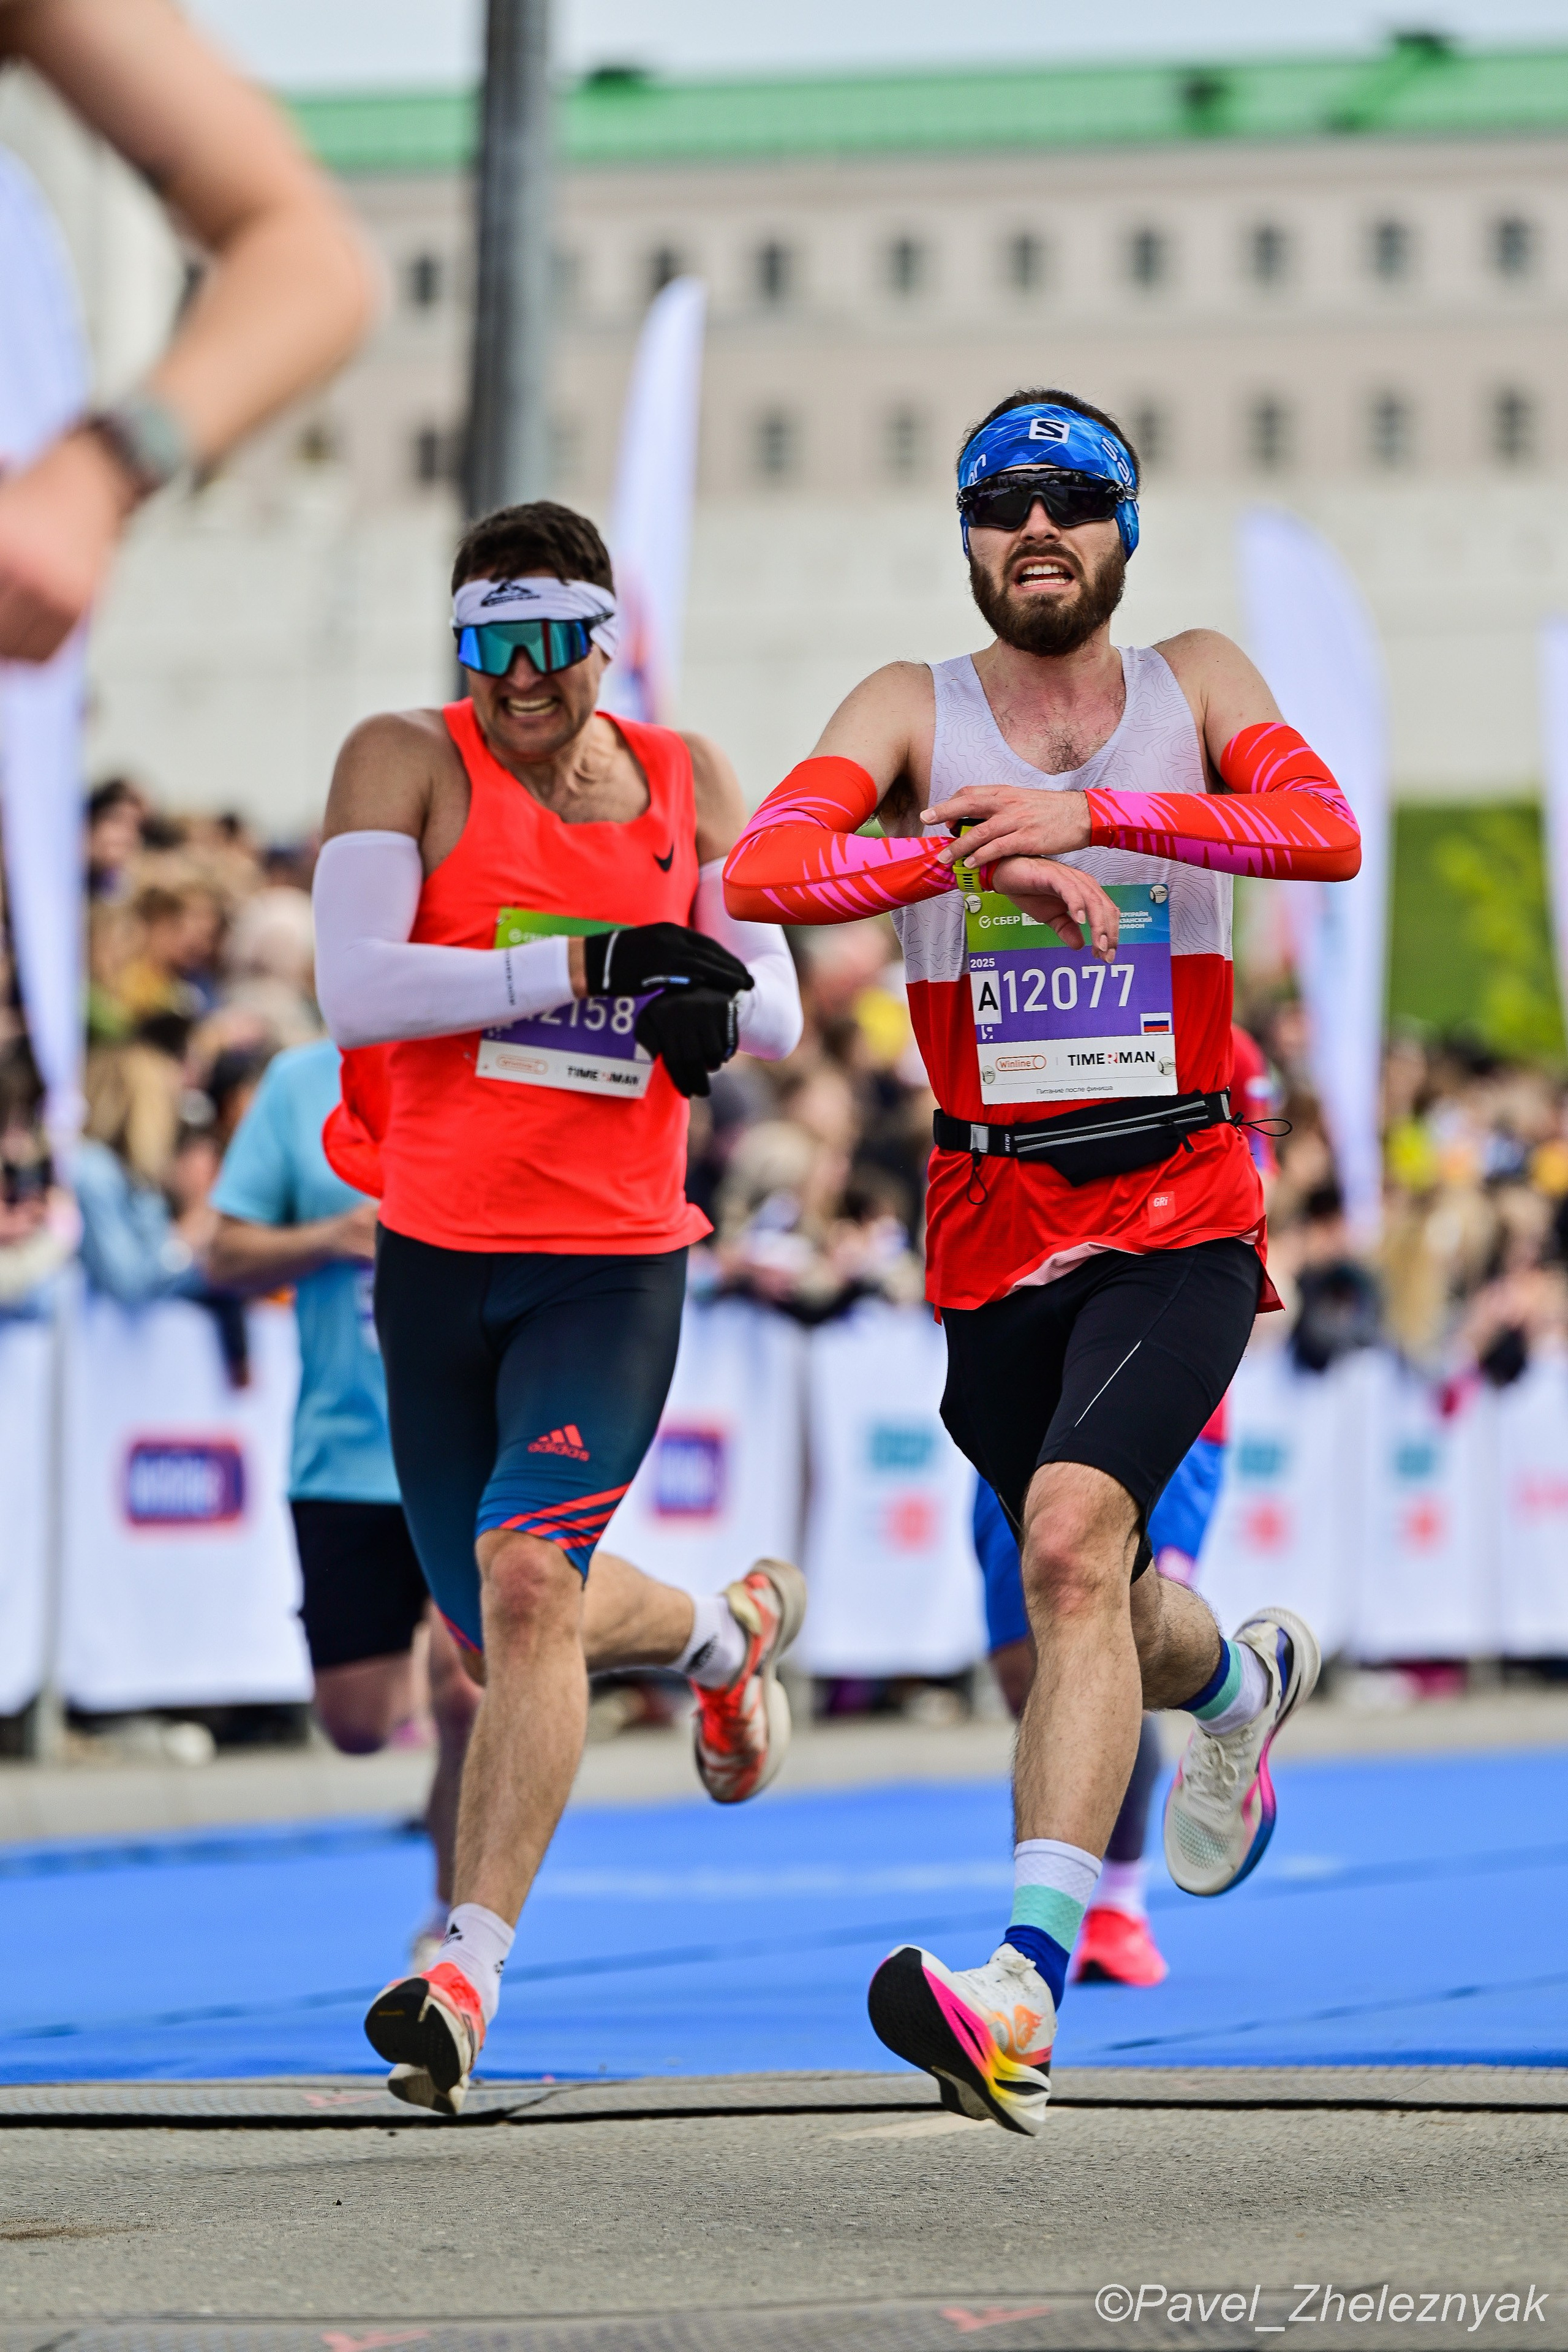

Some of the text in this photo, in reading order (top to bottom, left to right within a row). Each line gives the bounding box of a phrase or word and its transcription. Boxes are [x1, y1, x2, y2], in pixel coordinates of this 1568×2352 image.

[993, 916, 1021, 925] СБЕР
[970, 957, 995, 968] 2025
[978, 964, 1134, 1013] A 12077
[528, 996, 635, 1035] 158
